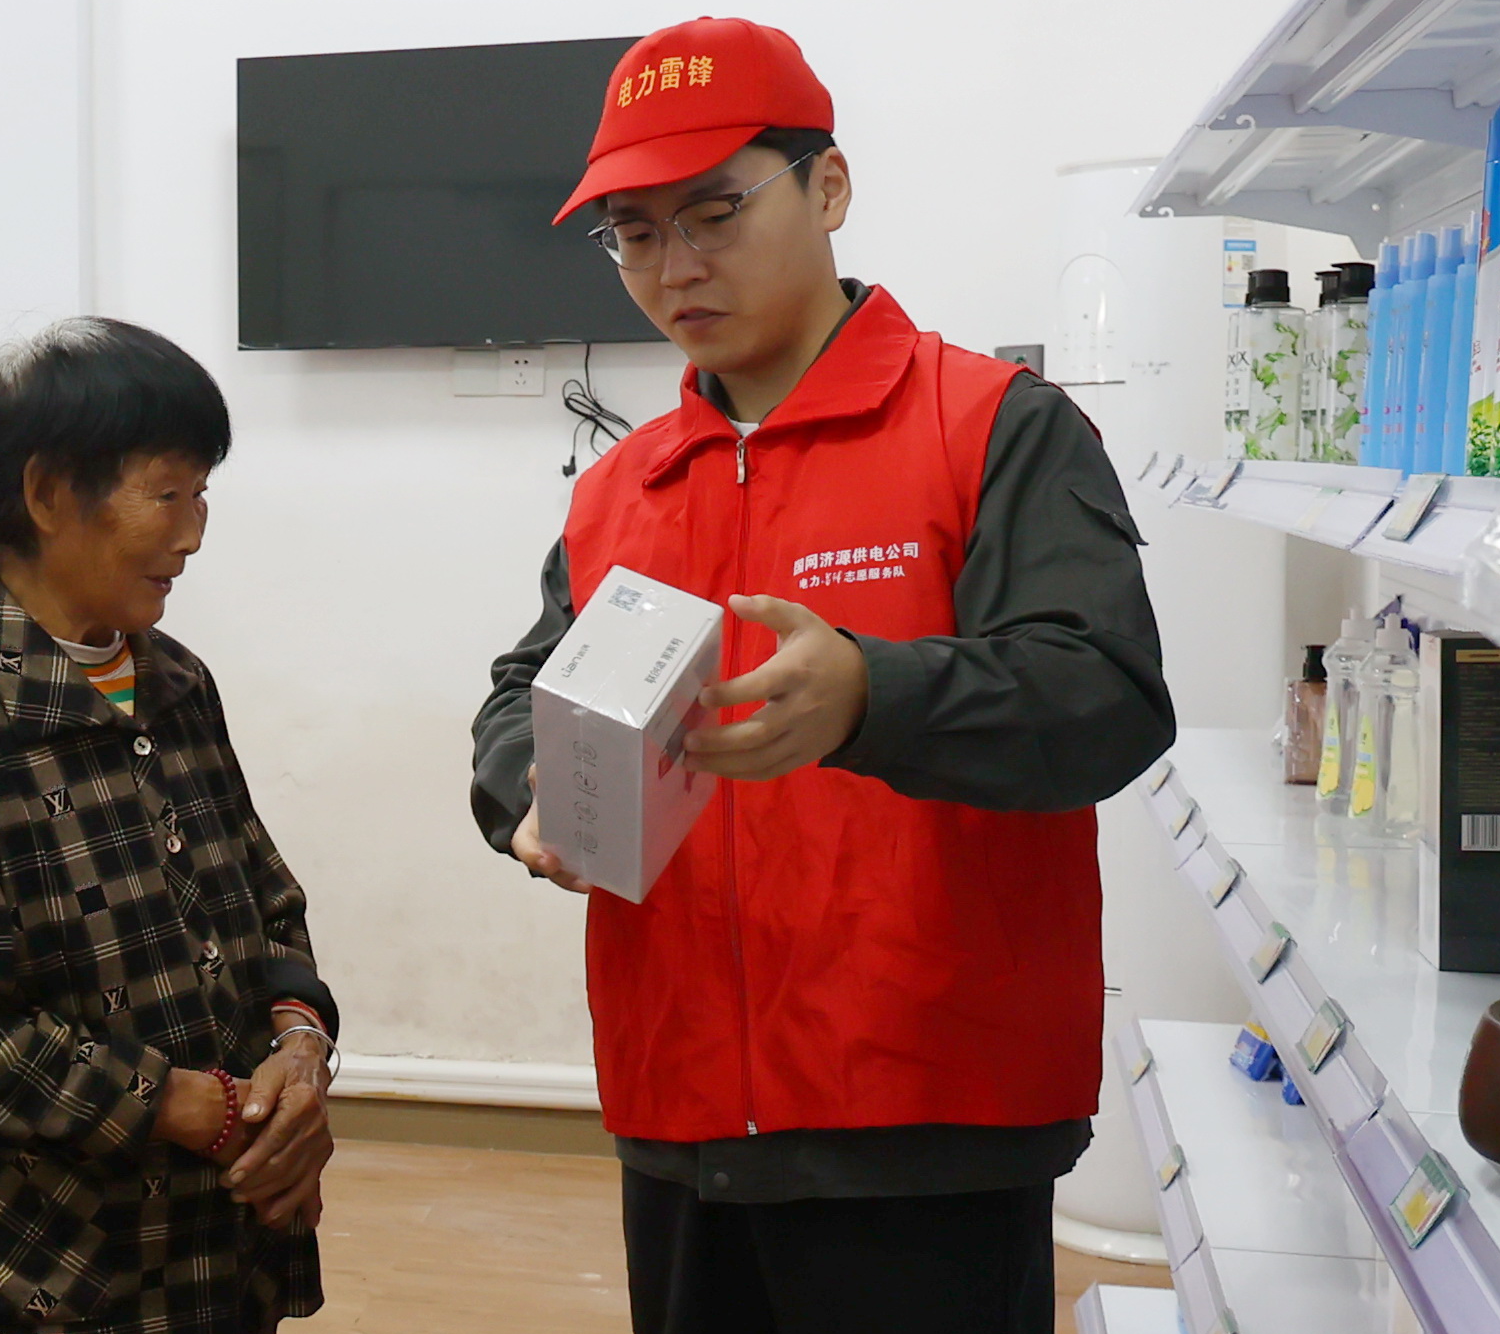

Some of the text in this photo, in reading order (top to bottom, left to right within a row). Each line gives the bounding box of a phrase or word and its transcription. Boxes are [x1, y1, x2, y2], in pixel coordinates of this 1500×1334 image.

[616, 55, 715, 109] 电力雷锋
[793, 541, 919, 576] 国网济源供电公司
